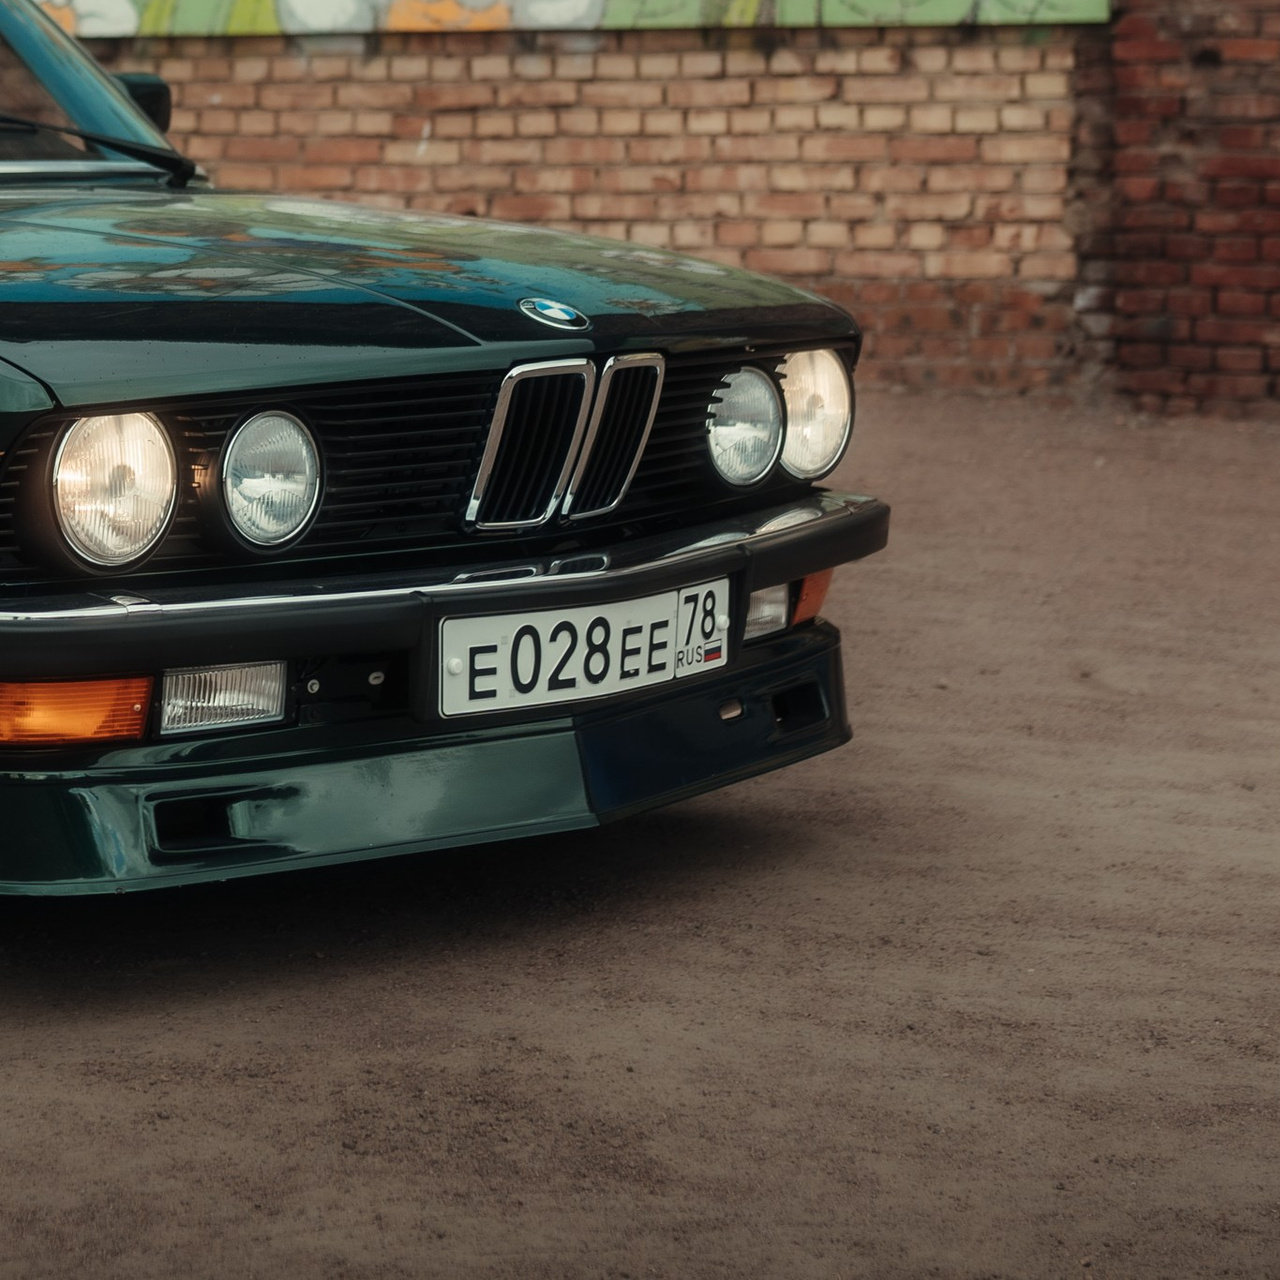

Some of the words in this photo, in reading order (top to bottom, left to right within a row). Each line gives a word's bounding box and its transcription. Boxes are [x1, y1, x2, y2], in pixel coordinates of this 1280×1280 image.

[468, 616, 670, 701] E028EE
[683, 589, 716, 646] 78
[676, 644, 703, 669] RUS
